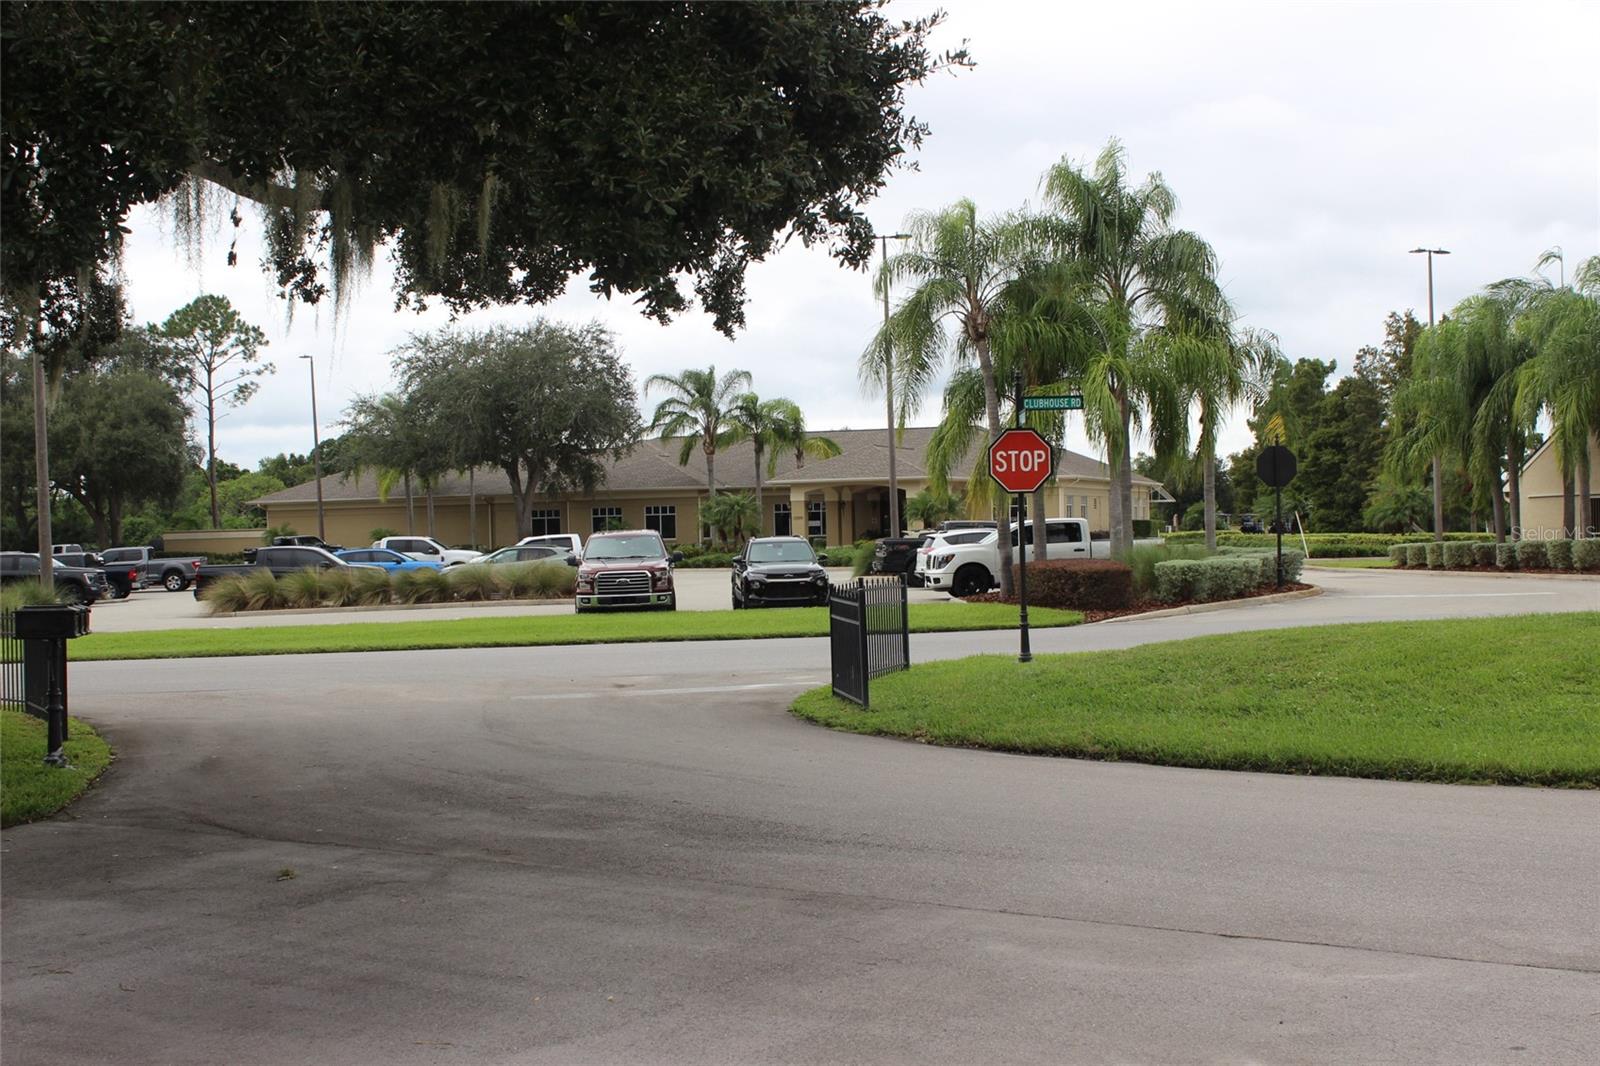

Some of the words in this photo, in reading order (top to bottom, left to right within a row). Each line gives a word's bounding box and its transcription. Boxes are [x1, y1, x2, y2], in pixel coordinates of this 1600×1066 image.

[1024, 398, 1069, 408] CLUBHOUSE
[1071, 398, 1081, 407] RD
[995, 450, 1046, 472] STOP
